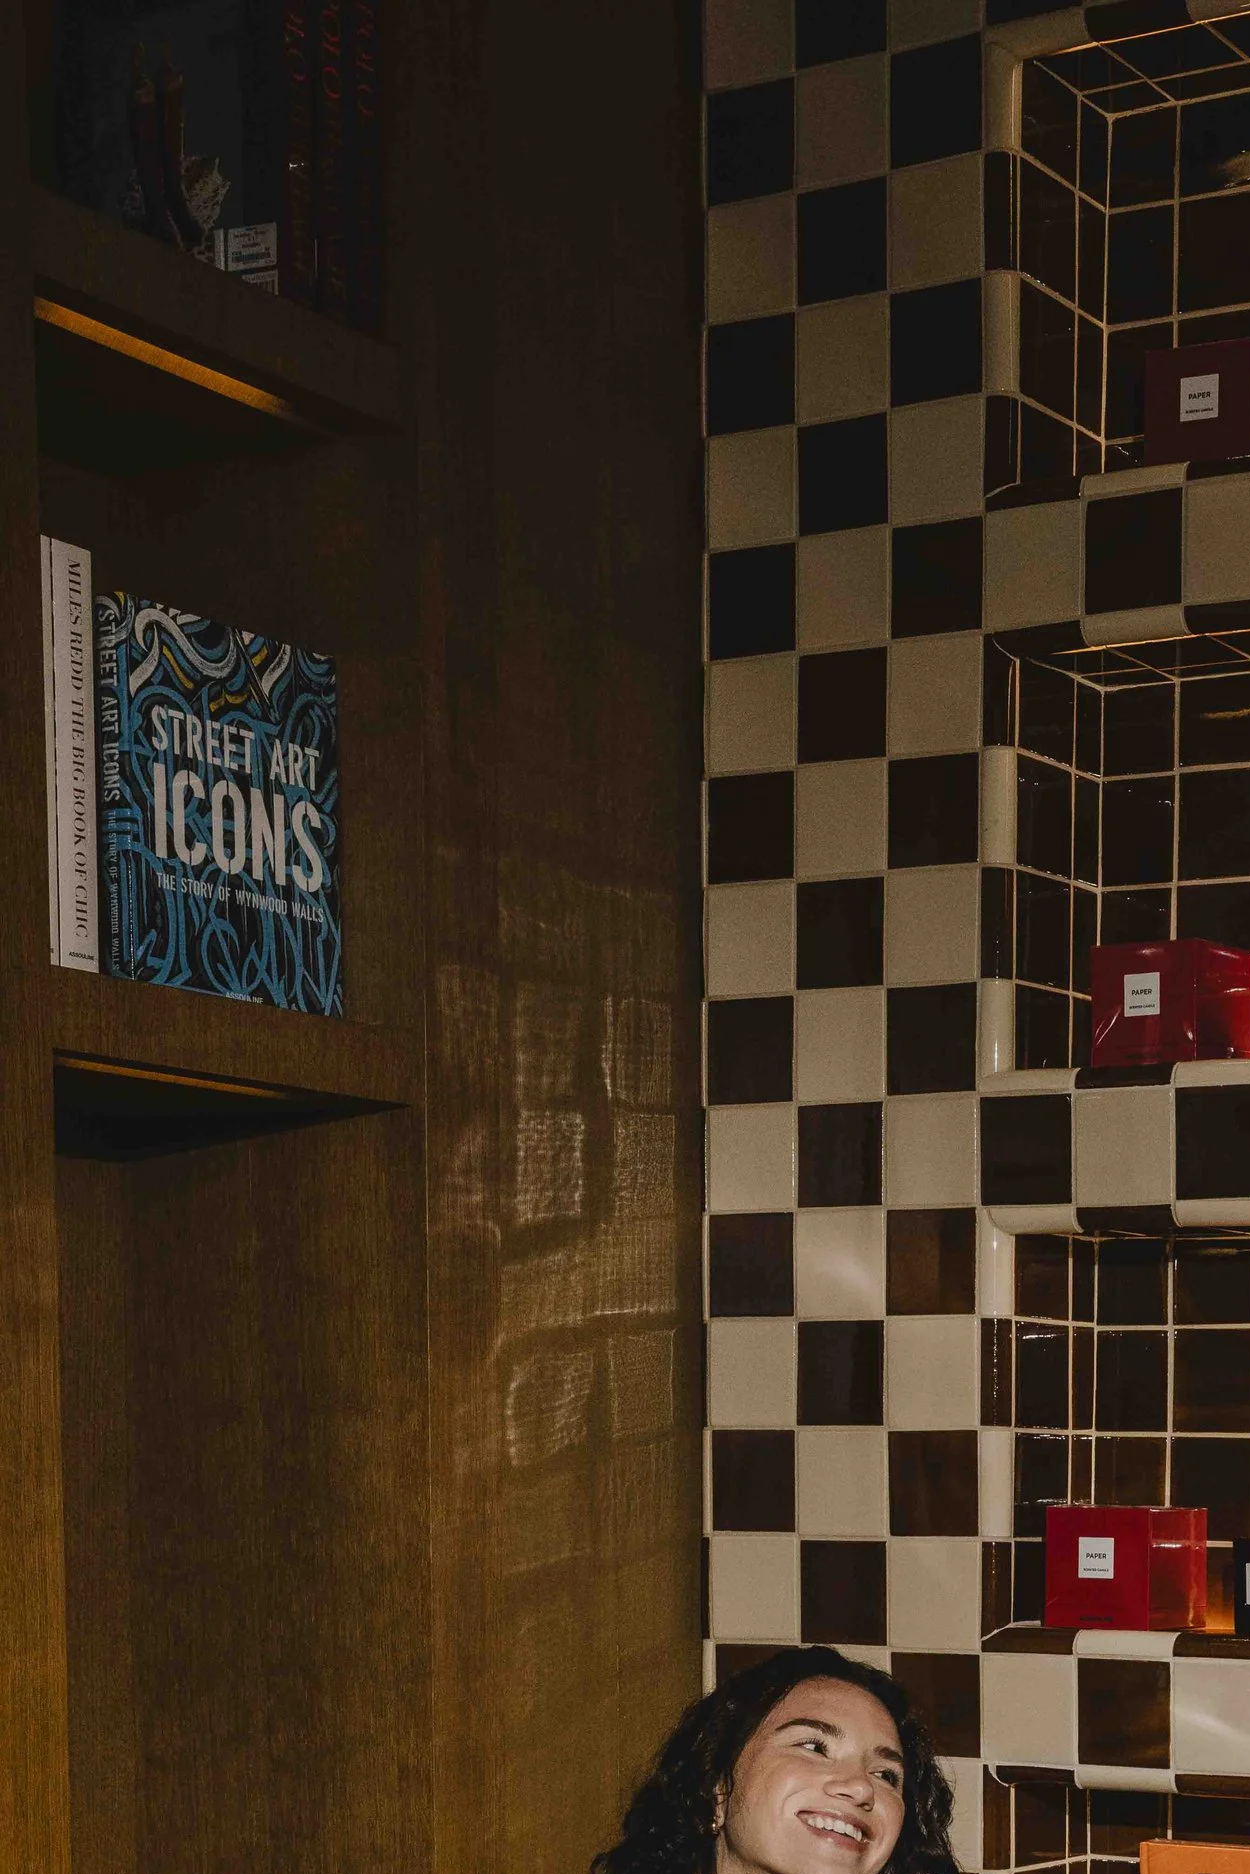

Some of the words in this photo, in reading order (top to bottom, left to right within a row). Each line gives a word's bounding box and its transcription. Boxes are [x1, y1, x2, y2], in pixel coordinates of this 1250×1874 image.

[1188, 391, 1211, 400] PAPER
[67, 558, 82, 625] MILES
[70, 631, 84, 691] REDD
[98, 609, 118, 687] STREET
[71, 699, 85, 740] THE
[101, 696, 119, 734] ART
[72, 745, 86, 781] BIG
[151, 704, 255, 774] STREET
[269, 738, 320, 791] ART
[103, 742, 121, 802] ICONS
[72, 790, 87, 845] BOOK
[108, 811, 116, 829] THE
[153, 762, 323, 893] ICONS
[74, 851, 88, 881] OF
[109, 832, 118, 862] STORY
[109, 866, 118, 880] OF
[74, 884, 89, 938] CHIC
[157, 872, 176, 891] THE
[181, 878, 214, 901] STORY
[218, 886, 231, 902] OF
[235, 889, 288, 915] WYNWOOD
[292, 901, 324, 923] WALLS
[112, 937, 120, 971] WALLS
[1131, 988, 1153, 996] PAPER
[1085, 1552, 1107, 1560] PAPER
